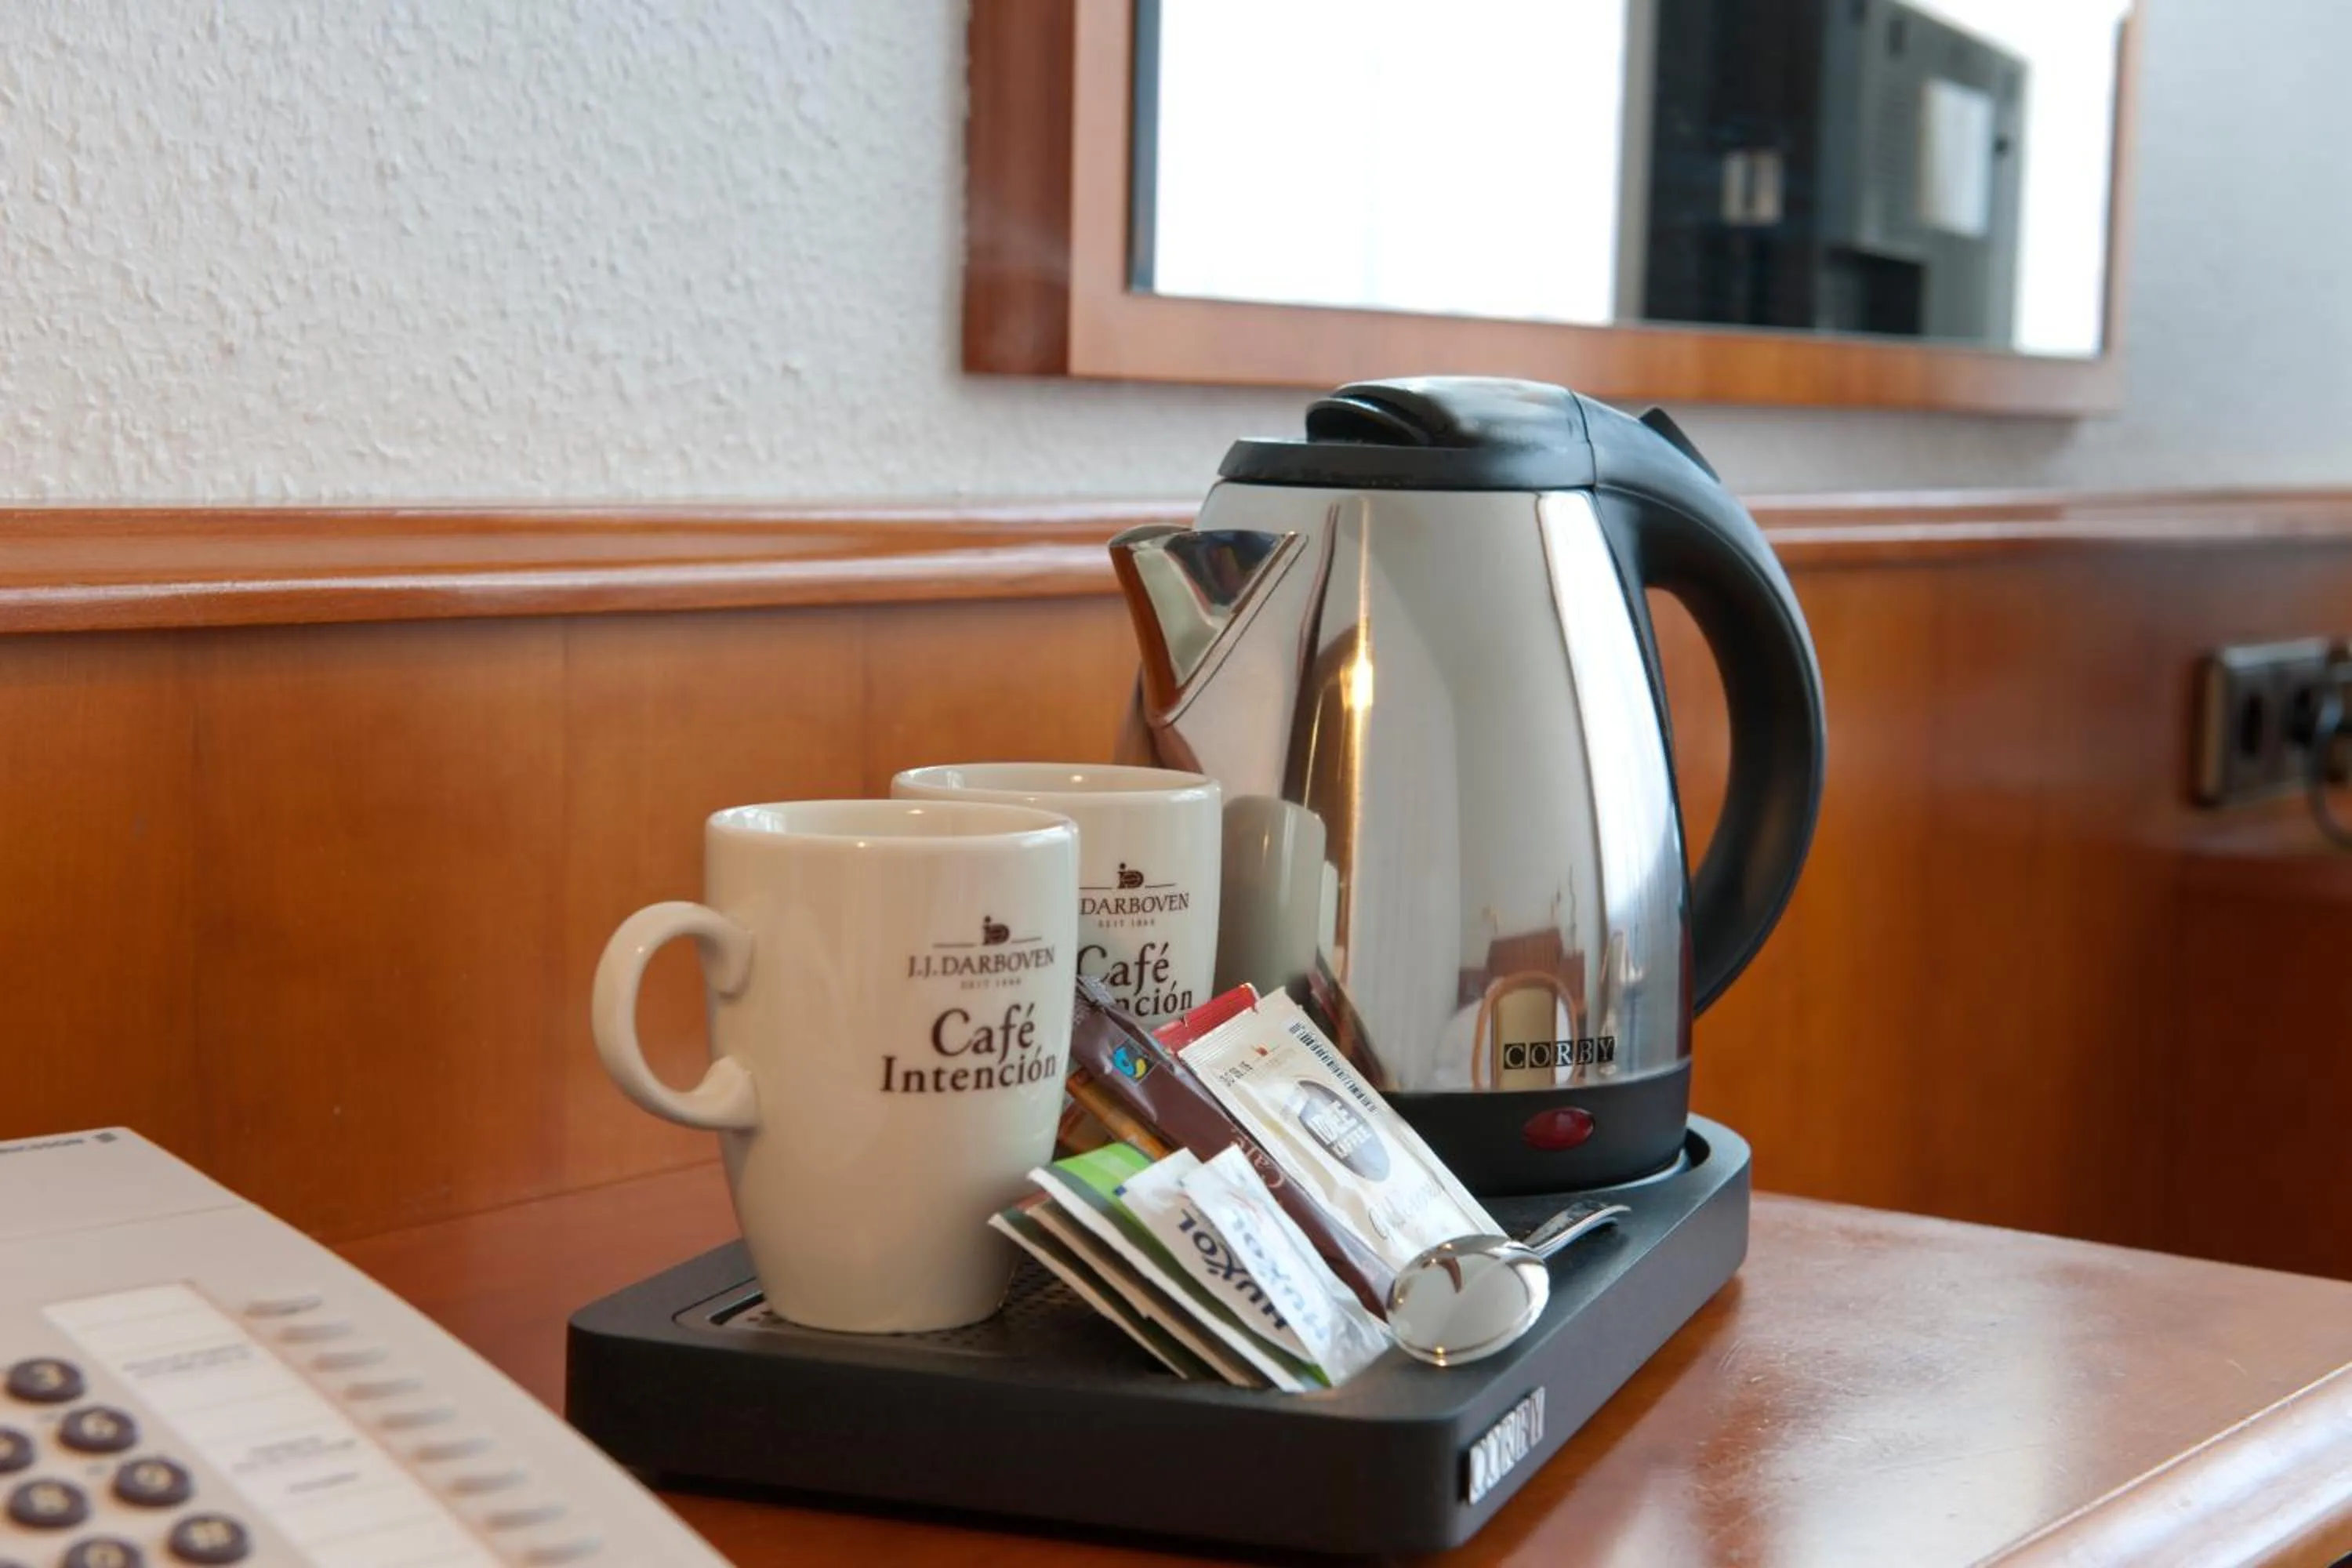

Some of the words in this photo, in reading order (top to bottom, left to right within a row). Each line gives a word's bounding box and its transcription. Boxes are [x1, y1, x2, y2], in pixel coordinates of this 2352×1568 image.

[1077, 941, 1170, 996] Café
[931, 1002, 1036, 1062] Café
[1504, 1036, 1614, 1069] CORBY
[879, 1046, 1058, 1094] Intención
[1177, 1207, 1289, 1331] HUXOL
